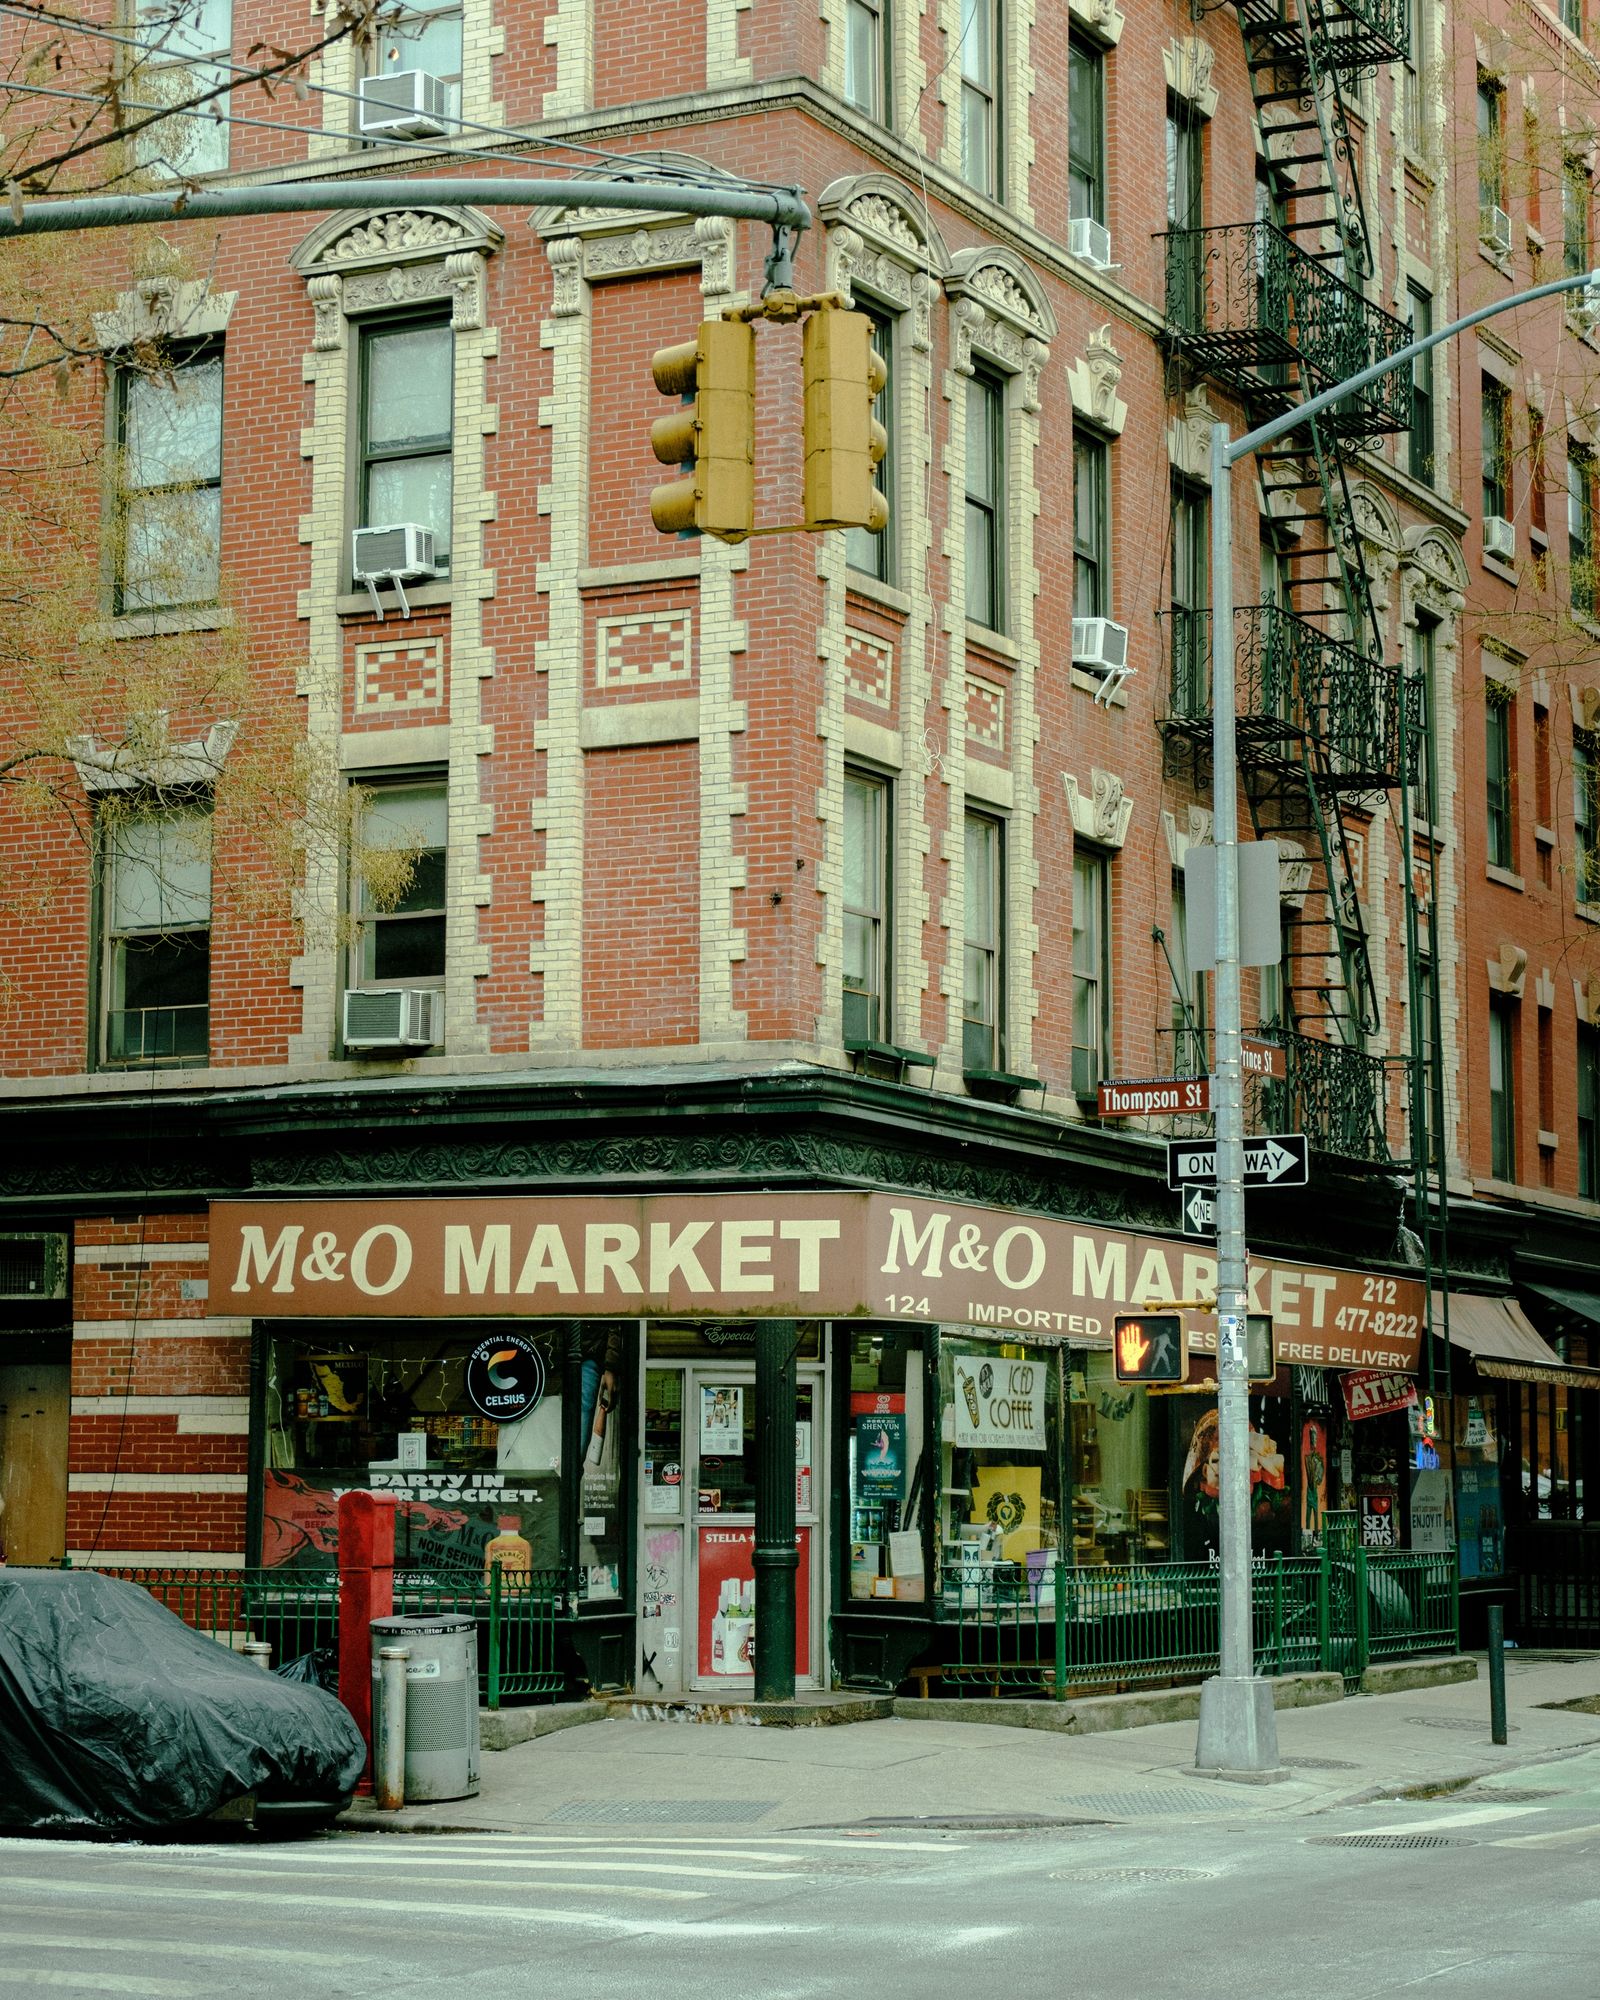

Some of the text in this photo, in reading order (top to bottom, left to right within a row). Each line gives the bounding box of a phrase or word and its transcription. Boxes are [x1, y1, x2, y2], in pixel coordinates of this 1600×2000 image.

[1240, 1046, 1273, 1074] rince St
[1103, 1084, 1202, 1114] Thompson St
[1188, 1152, 1285, 1174] ON WAY
[1193, 1201, 1211, 1222] ONE
[231, 1219, 841, 1296] M&O MARKET
[880, 1208, 1046, 1290] M&O
[1362, 1277, 1397, 1305] 212
[884, 1294, 1102, 1336] 124 IMPORTED
[1335, 1306, 1418, 1339] 477-8222
[704, 1326, 756, 1345] Especial
[472, 1336, 532, 1360] ESSENTIAL ENERGY
[1278, 1342, 1412, 1369] FREE DELIVERY
[1348, 1376, 1367, 1386] ATM
[1351, 1374, 1409, 1409] ATM
[485, 1394, 526, 1407] CELSIUS
[989, 1398, 1034, 1430] COFFEE
[369, 1474, 505, 1489] PARTY IN
[419, 1488, 544, 1503] POCKET.
[1363, 1497, 1368, 1516] I
[1363, 1515, 1391, 1531] SEX
[1412, 1513, 1442, 1528] ENJOY IT
[705, 1533, 747, 1543] STELLA
[1363, 1530, 1392, 1546] PAYS
[418, 1537, 486, 1569] NOW SERVIN
[400, 1628, 421, 1636] Don't
